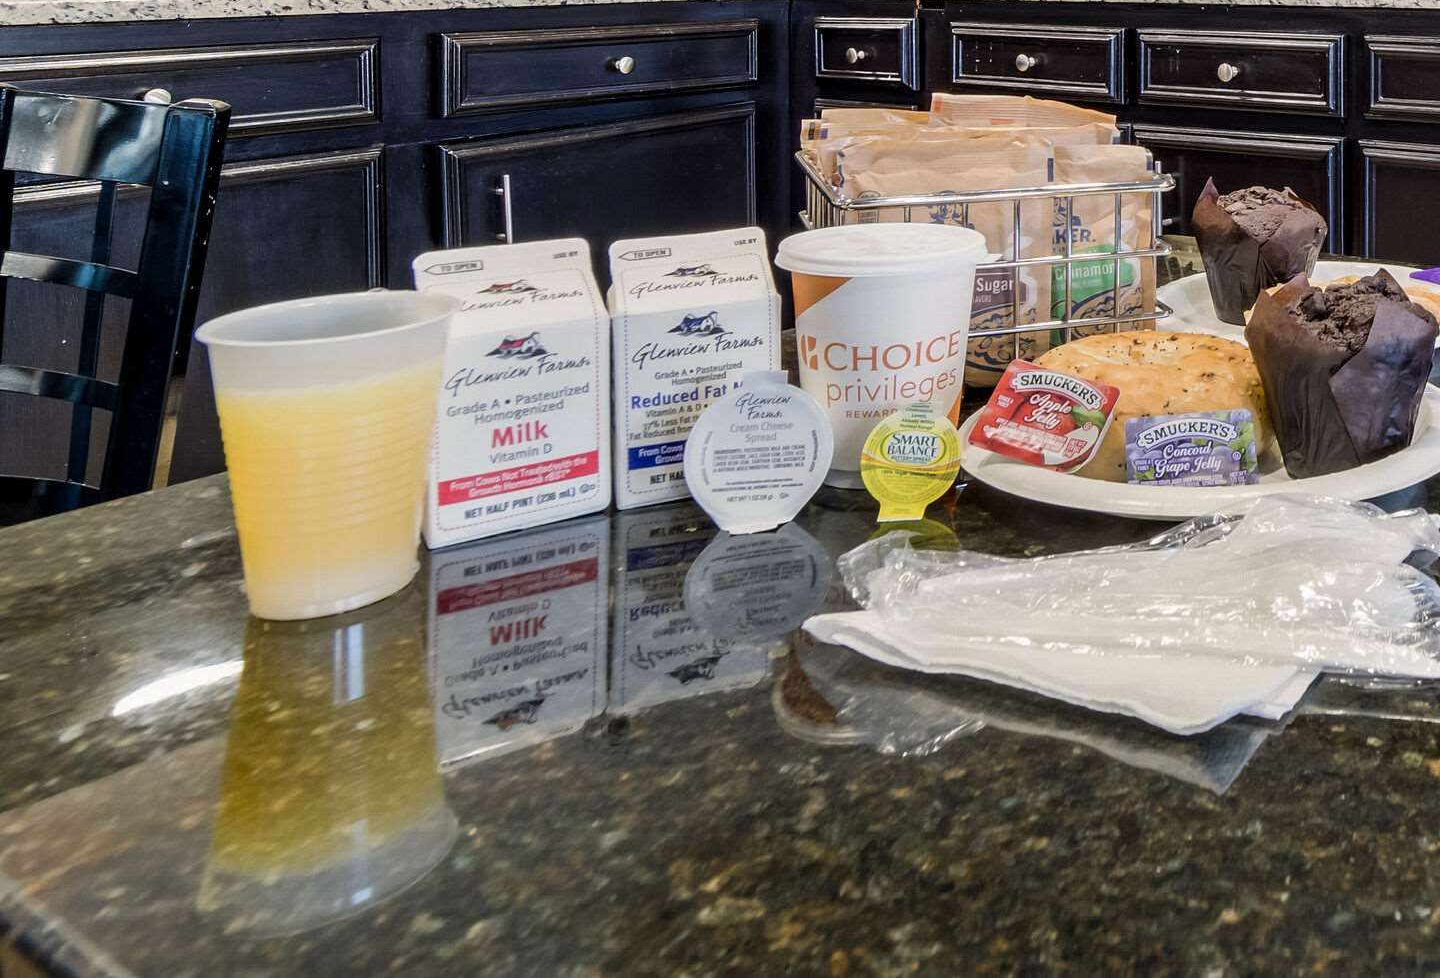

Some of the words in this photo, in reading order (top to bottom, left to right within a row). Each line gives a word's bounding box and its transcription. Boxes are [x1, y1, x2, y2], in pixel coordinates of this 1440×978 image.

[1052, 228, 1096, 244] KER.
[629, 280, 705, 299] Glenview
[461, 296, 523, 312] lenview
[632, 342, 711, 370] Glenview
[715, 332, 764, 354] Farms
[823, 330, 961, 372] CHOICE
[444, 367, 532, 397] Glenview
[537, 353, 591, 375] Farms
[654, 370, 679, 380] Grade
[681, 367, 687, 375] A
[696, 361, 743, 375] Pasteurized
[671, 372, 727, 386] Homogenized
[631, 387, 699, 409] Reduced
[705, 384, 727, 399] Fat
[826, 368, 957, 407] privileges
[1020, 374, 1098, 406] SMUCKER'S
[447, 399, 487, 417] Grade
[490, 399, 500, 408] A
[515, 382, 590, 405] Pasteurized
[735, 392, 792, 414] Glenview
[1029, 393, 1072, 415] Apple
[474, 399, 564, 424] Homogenized
[645, 406, 677, 418] Vitamin
[679, 405, 685, 413] A
[748, 406, 783, 420] Farms
[846, 408, 898, 418] REWARD
[1024, 409, 1060, 430] Jelly
[491, 420, 549, 449] Milk
[892, 433, 937, 447] SMART
[1143, 421, 1230, 445] SMUCKER'S
[489, 445, 539, 464] Vitamin
[543, 443, 552, 454] D
[887, 442, 937, 457] BALANCE
[1163, 440, 1212, 459] Concord
[1154, 459, 1190, 478] Grape
[1191, 455, 1222, 473] Jelly
[650, 474, 665, 484] NET
[669, 471, 685, 480] HAL
[464, 508, 484, 520] NET
[486, 501, 510, 516] HALF
[512, 496, 534, 509] PINT
